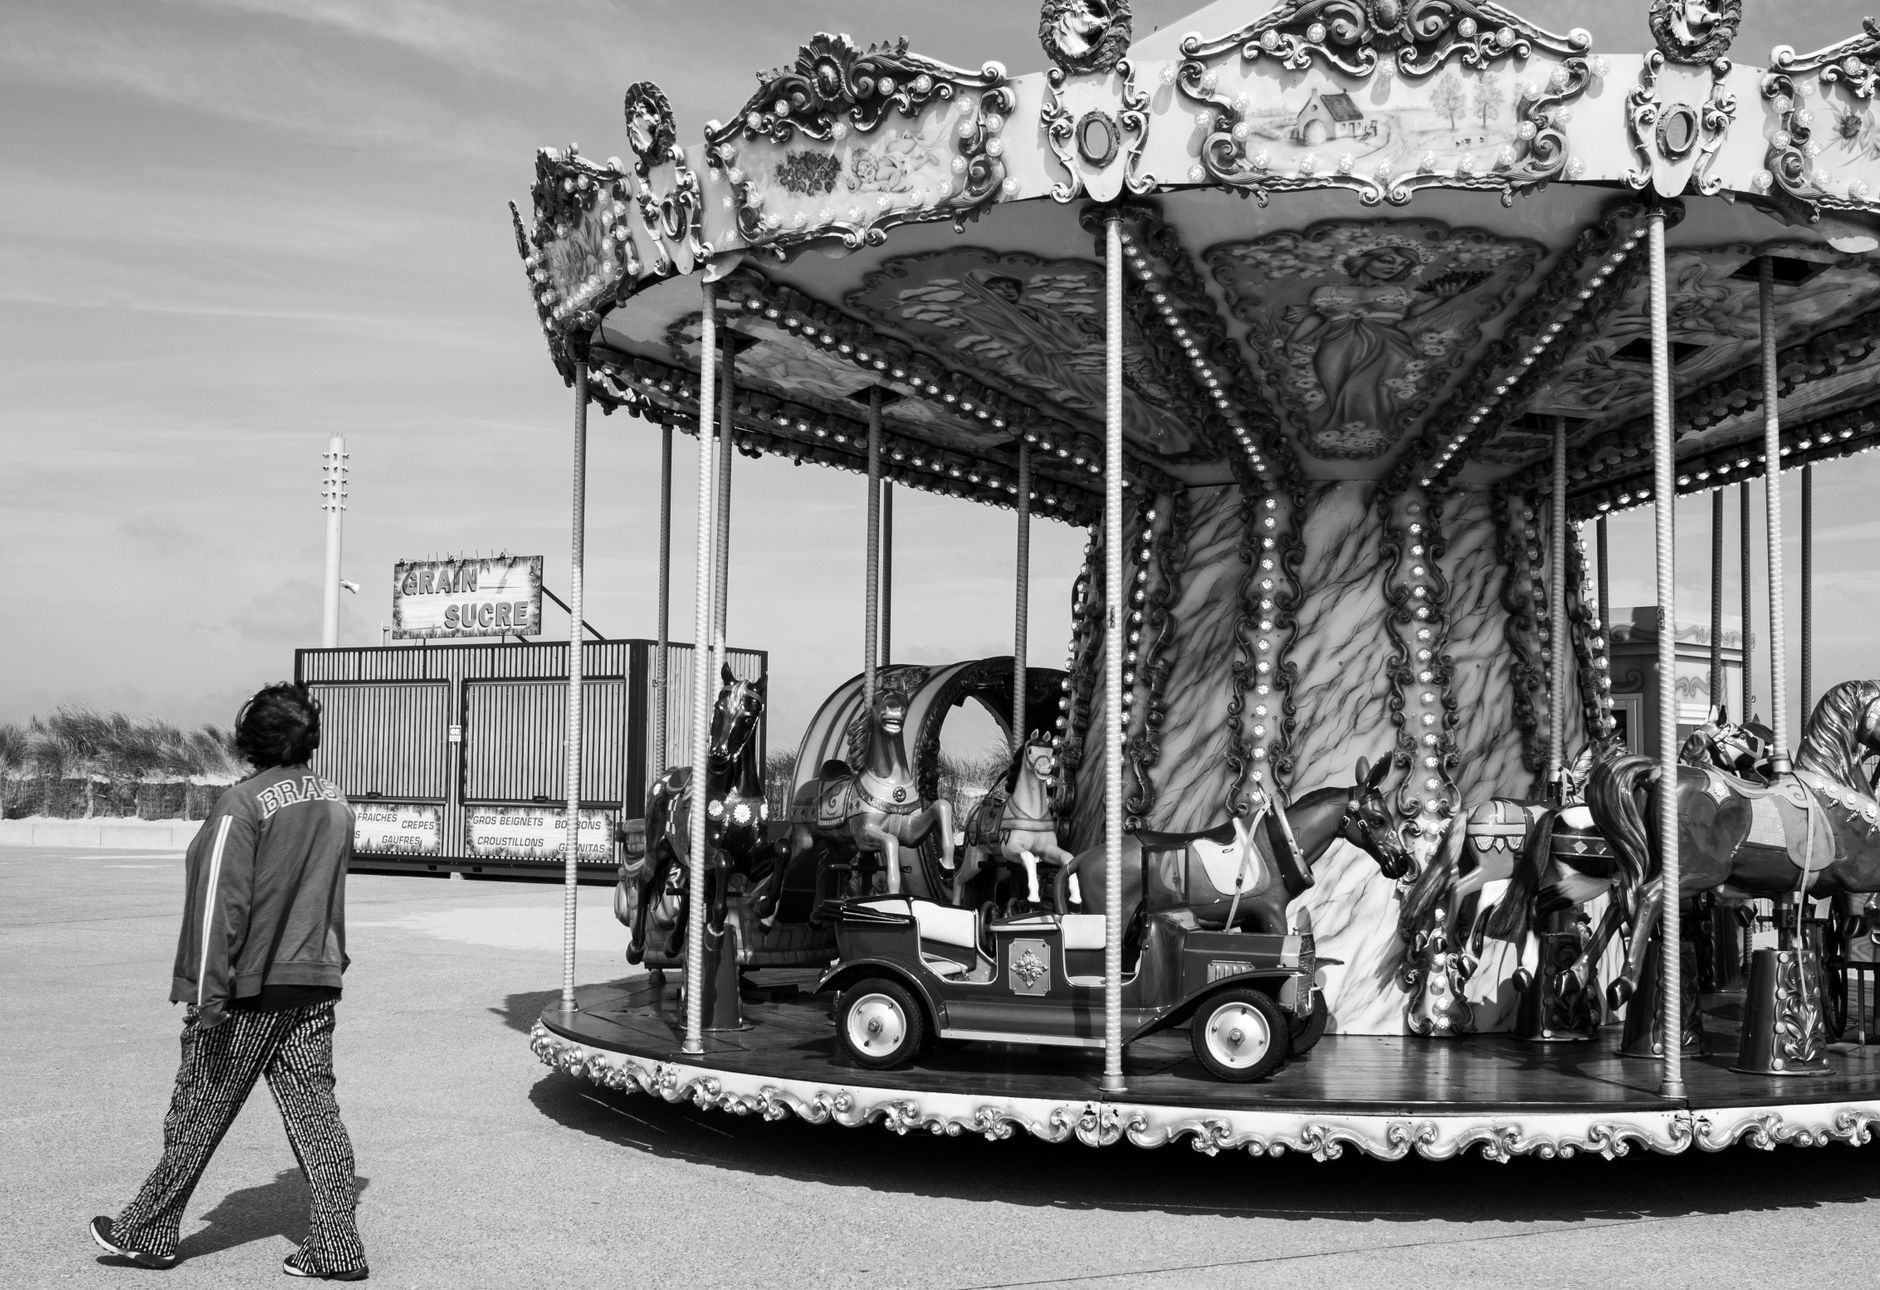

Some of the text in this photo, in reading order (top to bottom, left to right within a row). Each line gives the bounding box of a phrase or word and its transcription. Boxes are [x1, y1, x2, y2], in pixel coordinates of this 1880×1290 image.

[402, 567, 477, 596] GRAIN
[444, 601, 529, 629] SUCRE
[256, 775, 346, 819] BRAS
[357, 812, 398, 822] FRAICHES
[472, 815, 544, 827] GROS BEIGNETS
[401, 820, 435, 830] CREPES
[554, 819, 602, 830] BOSONS
[381, 835, 421, 845] GAUFRES
[477, 836, 544, 847] CROUSTILLONS
[558, 842, 606, 853] GNITAS
